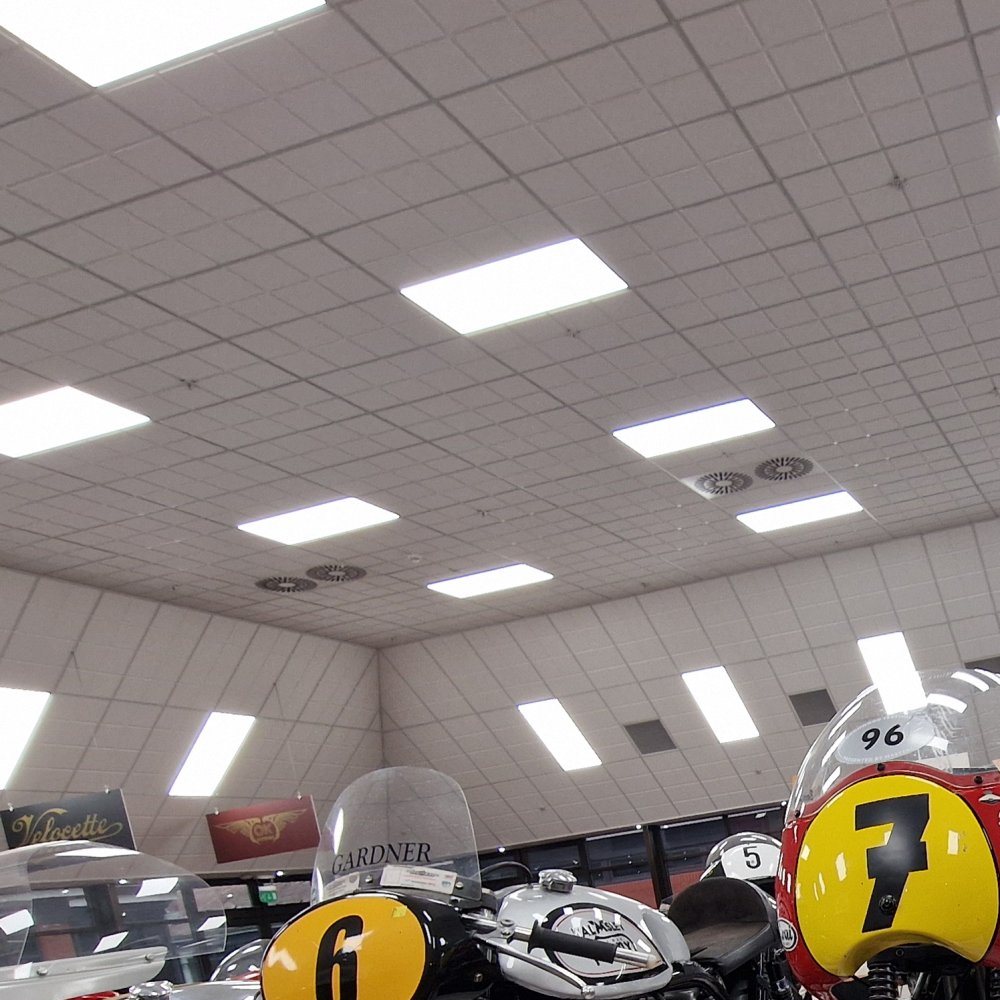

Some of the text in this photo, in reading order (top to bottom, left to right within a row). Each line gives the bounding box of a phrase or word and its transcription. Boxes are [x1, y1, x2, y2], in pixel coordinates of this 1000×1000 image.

[860, 724, 904, 750] 96
[11, 808, 123, 846] Velocette
[332, 842, 432, 875] GARDNER
[744, 845, 761, 869] 5
[854, 793, 930, 933] 7
